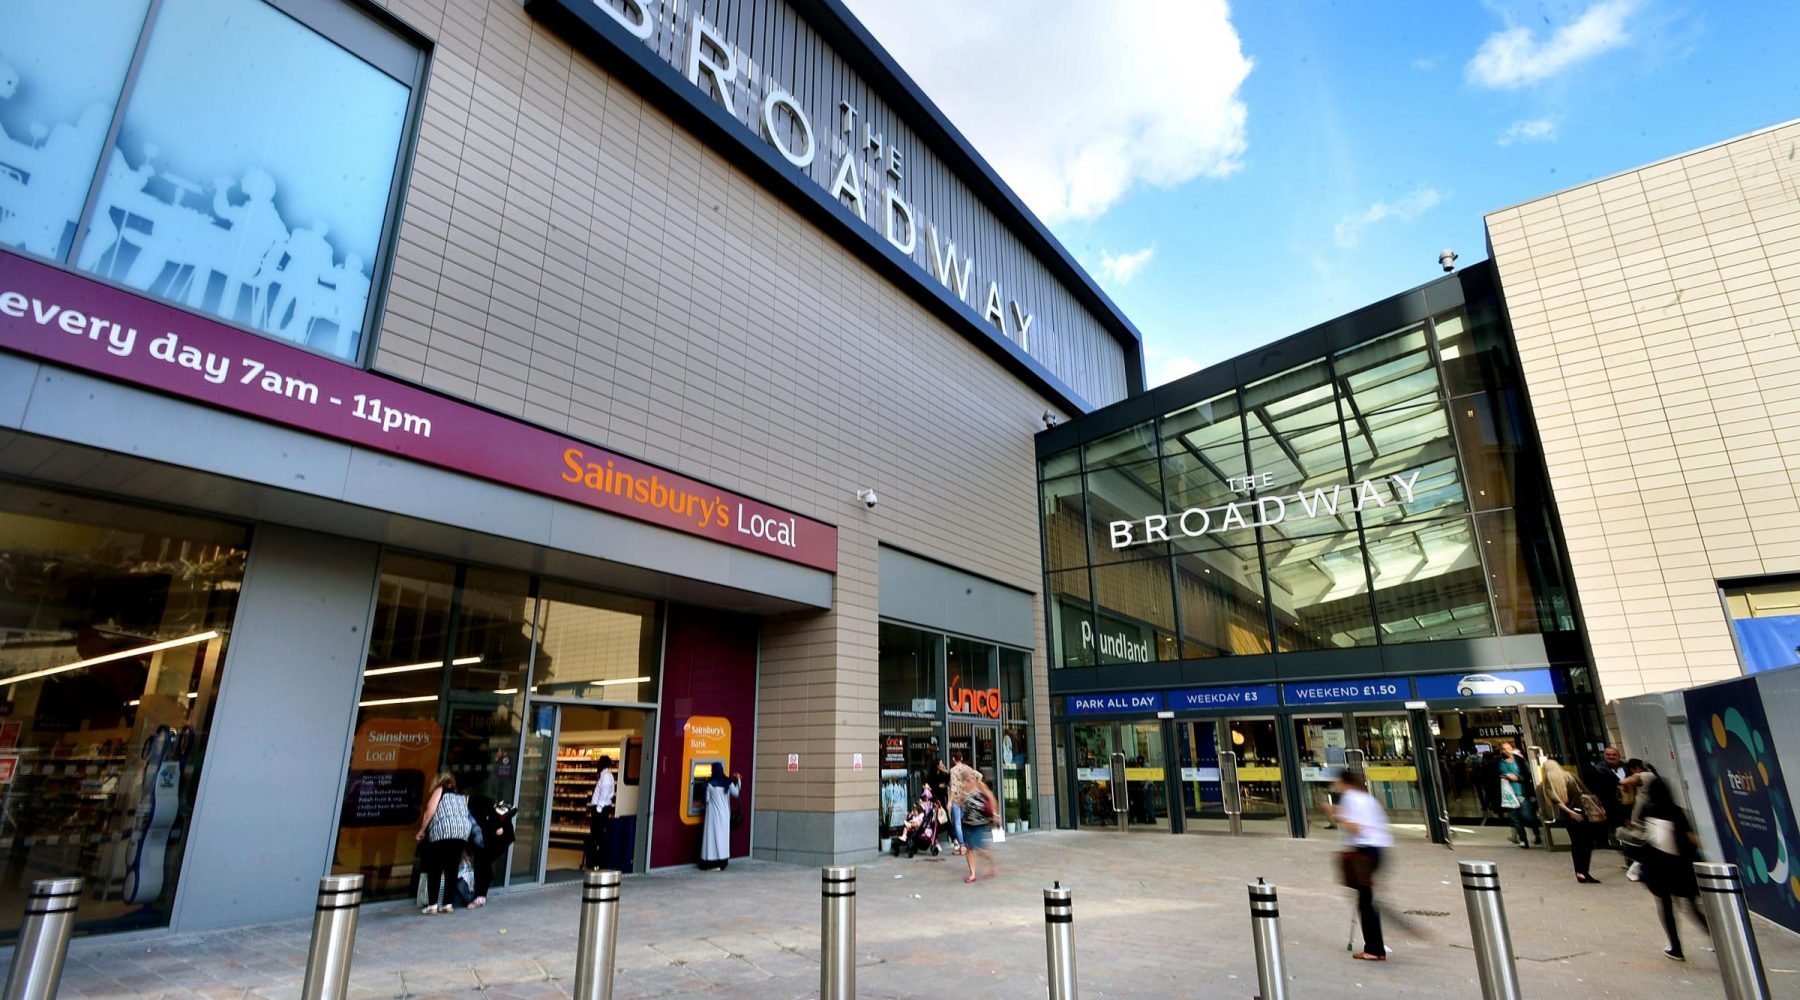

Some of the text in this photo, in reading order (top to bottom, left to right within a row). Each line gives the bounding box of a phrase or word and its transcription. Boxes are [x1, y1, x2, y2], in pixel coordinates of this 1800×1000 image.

[840, 100, 903, 181] THE
[0, 290, 137, 356] every
[149, 332, 230, 384] day
[241, 358, 319, 404] 7am
[352, 394, 432, 437] 11pm
[1226, 472, 1275, 493] THE
[562, 448, 795, 547] Sainsbury's Local
[1109, 471, 1421, 549] BROADWAY
[1187, 691, 1258, 704] WEEKDAY £3
[1296, 685, 1397, 698] WEEKEND £1.50
[1076, 696, 1155, 709] PARK ALL DAY
[691, 725, 725, 737] Sainsbury's
[368, 731, 430, 746] Sainsbury's
[691, 739, 705, 748] Bank
[366, 749, 396, 761] Local
